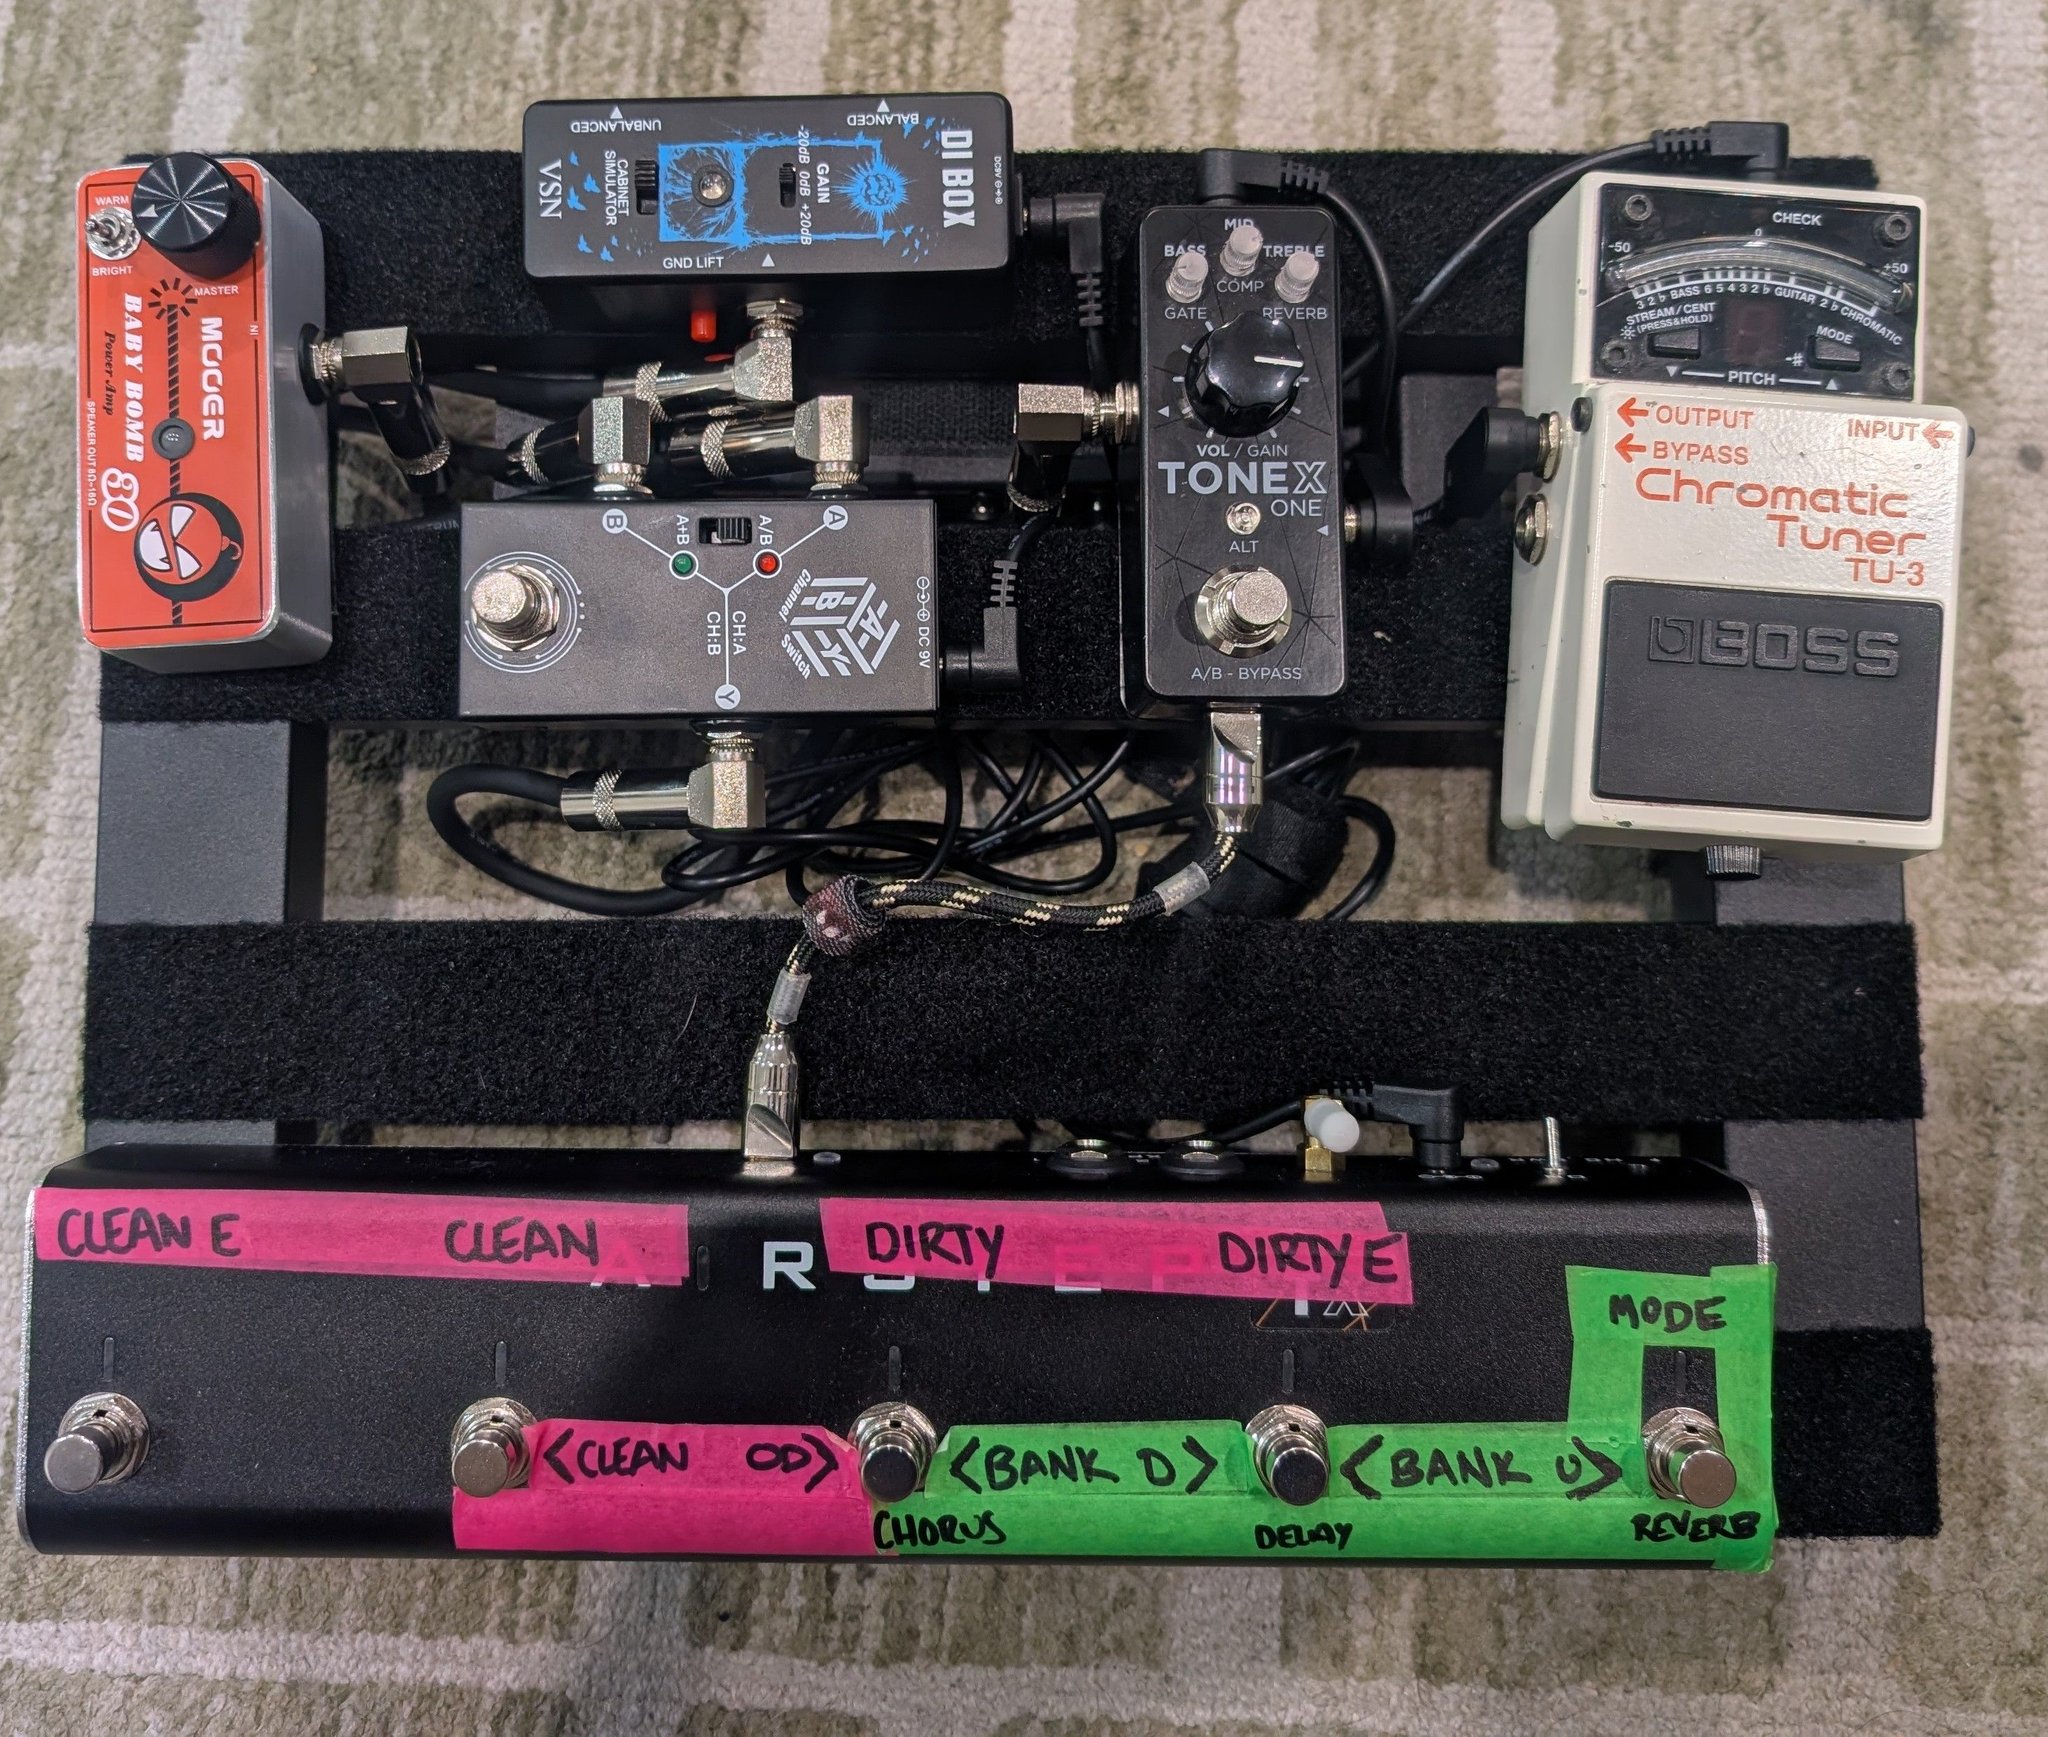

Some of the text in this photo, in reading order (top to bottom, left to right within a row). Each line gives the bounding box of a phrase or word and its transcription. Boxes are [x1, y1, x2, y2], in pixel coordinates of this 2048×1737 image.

[570, 119, 662, 133] UNBALANCED
[847, 113, 919, 126] BALANCED
[539, 159, 563, 220] VSN
[604, 150, 617, 226] SIMULATOR
[617, 159, 630, 216] CABINET
[799, 171, 810, 197] 0dB
[816, 163, 830, 204] GAIN
[941, 129, 975, 228] DI BOX
[95, 196, 130, 206] WARM
[800, 205, 812, 245] +20dB
[1755, 228, 1763, 237] 0
[1772, 211, 1822, 226] CHECK
[663, 256, 724, 269] GND LIFT
[1607, 242, 1631, 253] -50
[92, 265, 133, 276] BRIGHT
[1883, 262, 1908, 274] +50
[194, 285, 240, 296] MASTER
[1216, 281, 1264, 293] COMP
[1164, 308, 1208, 319] GATE
[1262, 308, 1328, 319] REVERB
[1670, 286, 1700, 299] BASS
[1774, 287, 1816, 305] GUITAR
[1840, 306, 1903, 345] CHROMATIC
[1816, 325, 1854, 345] MODE
[103, 330, 116, 415] Power Amp
[124, 293, 145, 463] BABY BOMB
[1727, 370, 1776, 386] PITCH
[87, 401, 96, 446] SPEAKER
[1655, 405, 1753, 430] OUTPUT
[1848, 419, 1920, 441] INPUT
[87, 448, 97, 467] OUT
[1196, 444, 1230, 457] VOL
[1247, 444, 1288, 457] GAIN
[1652, 441, 1749, 465] BYPASS
[1158, 461, 1328, 495] TONEX
[1635, 467, 1908, 518] Chromatic
[101, 467, 140, 532] 80
[1270, 499, 1322, 517] ONE
[676, 514, 690, 545] A+B
[758, 514, 774, 546] A/B
[1766, 513, 1927, 556] Tuner
[1229, 540, 1259, 553] ALT
[1844, 557, 1925, 587] TU-3
[778, 568, 811, 623] Channel
[707, 611, 721, 656] CH:B
[732, 610, 747, 656] CH:A
[918, 627, 931, 669] DC 9V
[1701, 618, 1900, 677] BOSS
[781, 633, 811, 680] Switch
[1191, 667, 1222, 681] A/B
[1238, 667, 1302, 681] BYPASS
[57, 1207, 241, 1258] CLEAN E
[445, 1217, 599, 1266] CLEAN
[865, 1221, 1005, 1279] DIRTY
[1218, 1231, 1402, 1289] DIRTY E
[1609, 1293, 1727, 1333] MODE
[873, 1510, 1007, 1551] CHORUS
[1630, 1511, 1761, 1542] REVERB
